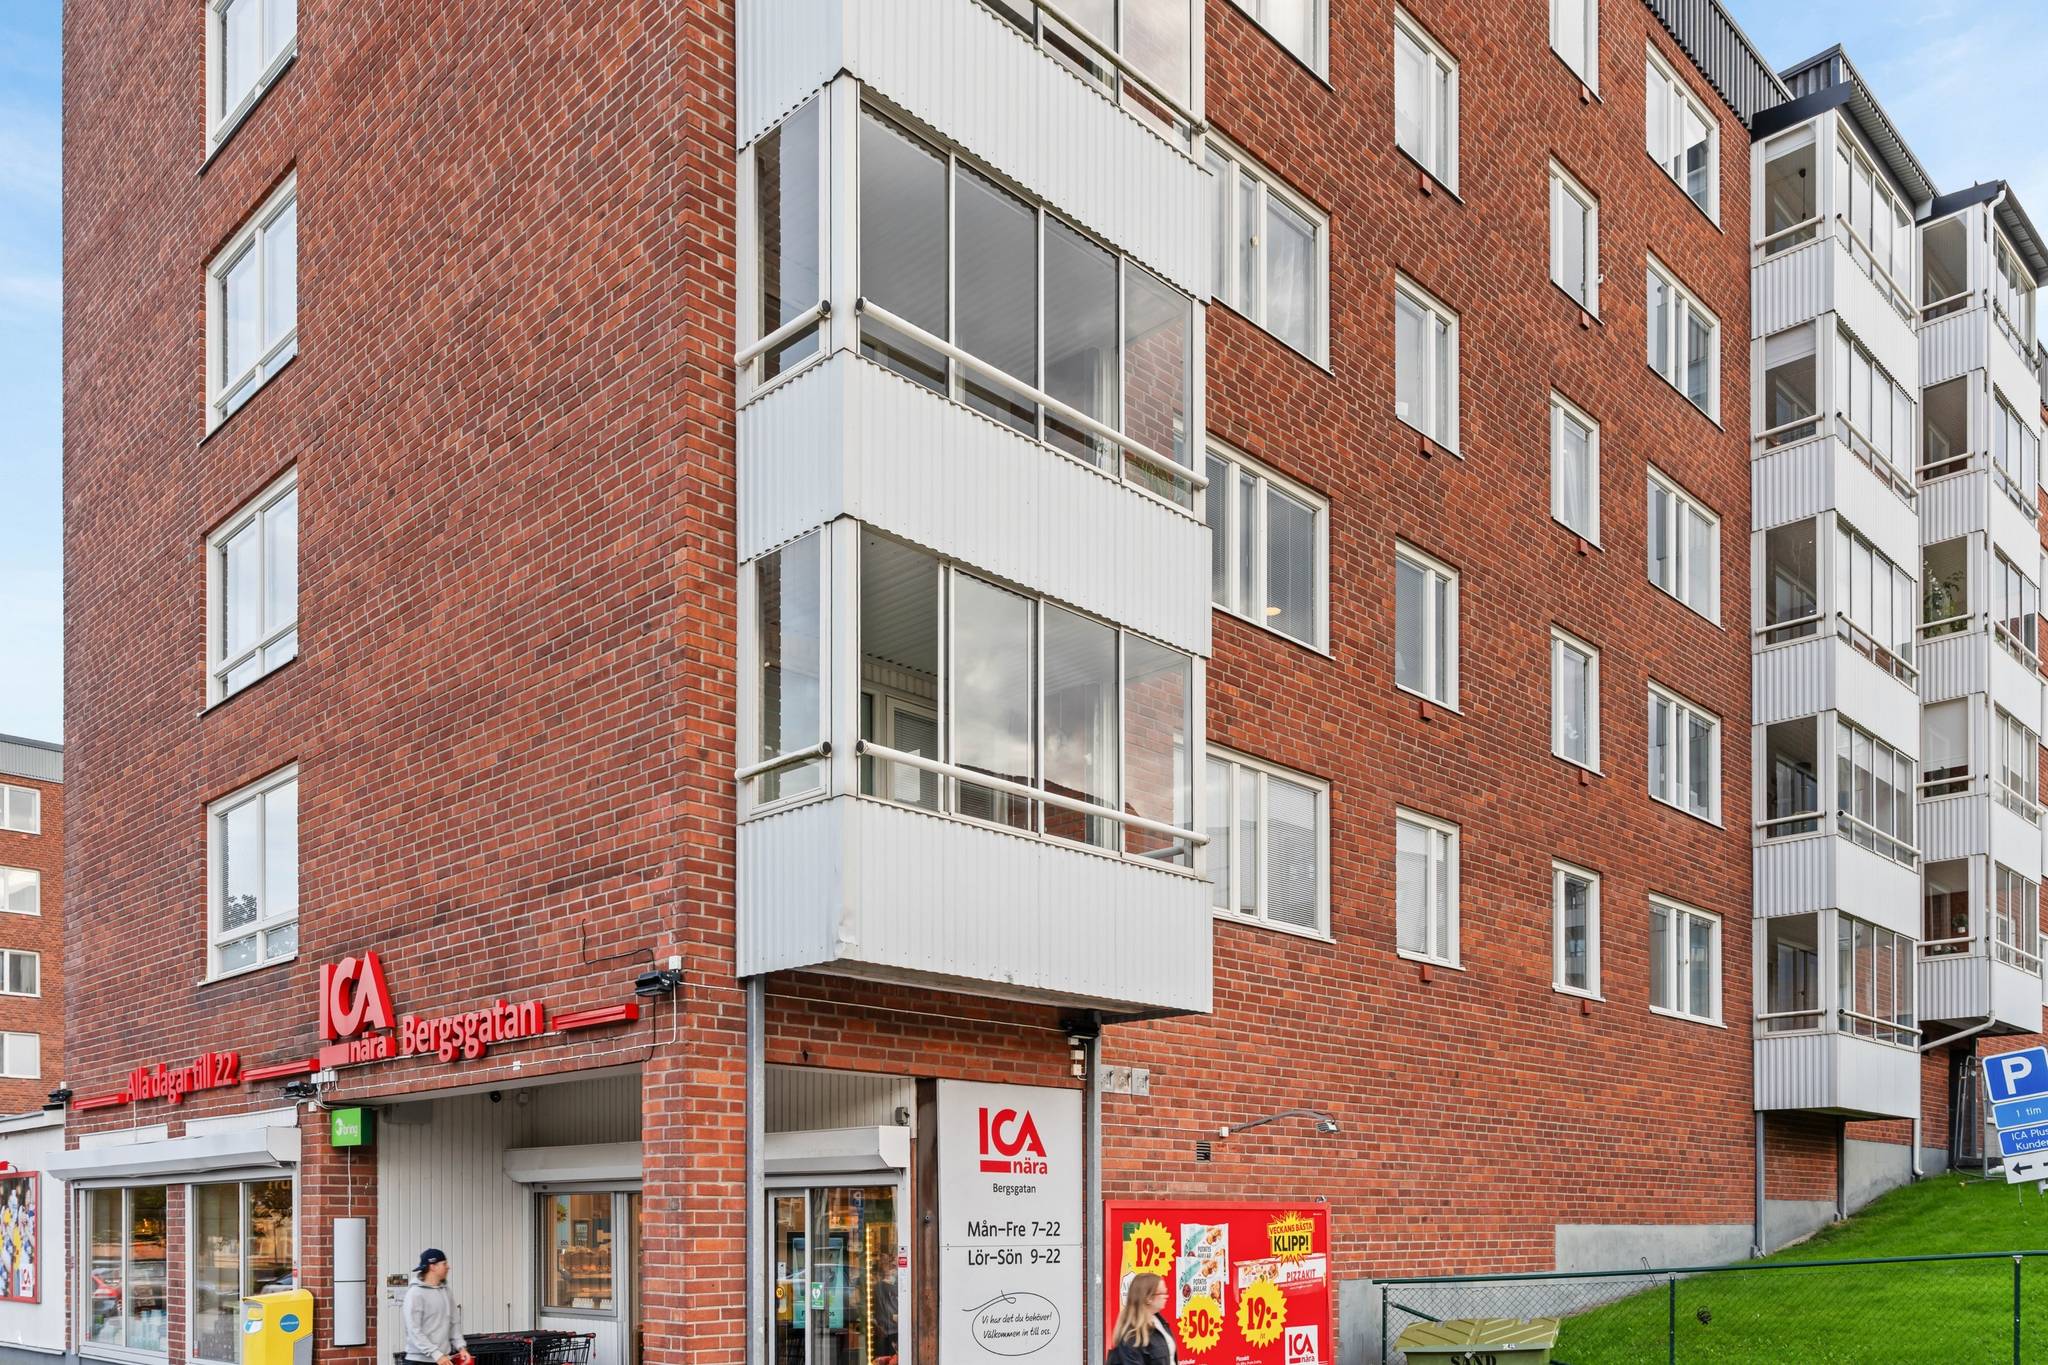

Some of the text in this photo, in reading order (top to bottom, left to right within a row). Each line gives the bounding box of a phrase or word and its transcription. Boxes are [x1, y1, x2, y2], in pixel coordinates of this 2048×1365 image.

[320, 950, 393, 1039] ICA
[403, 1000, 540, 1062] Bergsgatan
[350, 1031, 390, 1063] nära
[127, 1052, 236, 1104] Alla dagar till 22
[2001, 1056, 2032, 1095] P
[2016, 1107, 2042, 1118] 1 tim
[979, 1107, 1047, 1158] ICA
[2011, 1131, 2028, 1141] ICA
[1013, 1157, 1048, 1175] nära
[992, 1183, 1037, 1196] Bergsgatan
[1269, 1224, 1295, 1235] VECKANS
[1135, 1237, 1166, 1267] 19:-
[1273, 1235, 1309, 1252] KLIPP!
[1286, 1268, 1316, 1281] PIZZAKIT
[982, 1311, 1053, 1324] Vi har det du behöver!
[1188, 1309, 1220, 1338] 50:-
[1247, 1296, 1277, 1330] 19:-
[983, 1329, 1020, 1339] Välkommen
[1030, 1326, 1040, 1336] till
[1289, 1333, 1314, 1356] ICA
